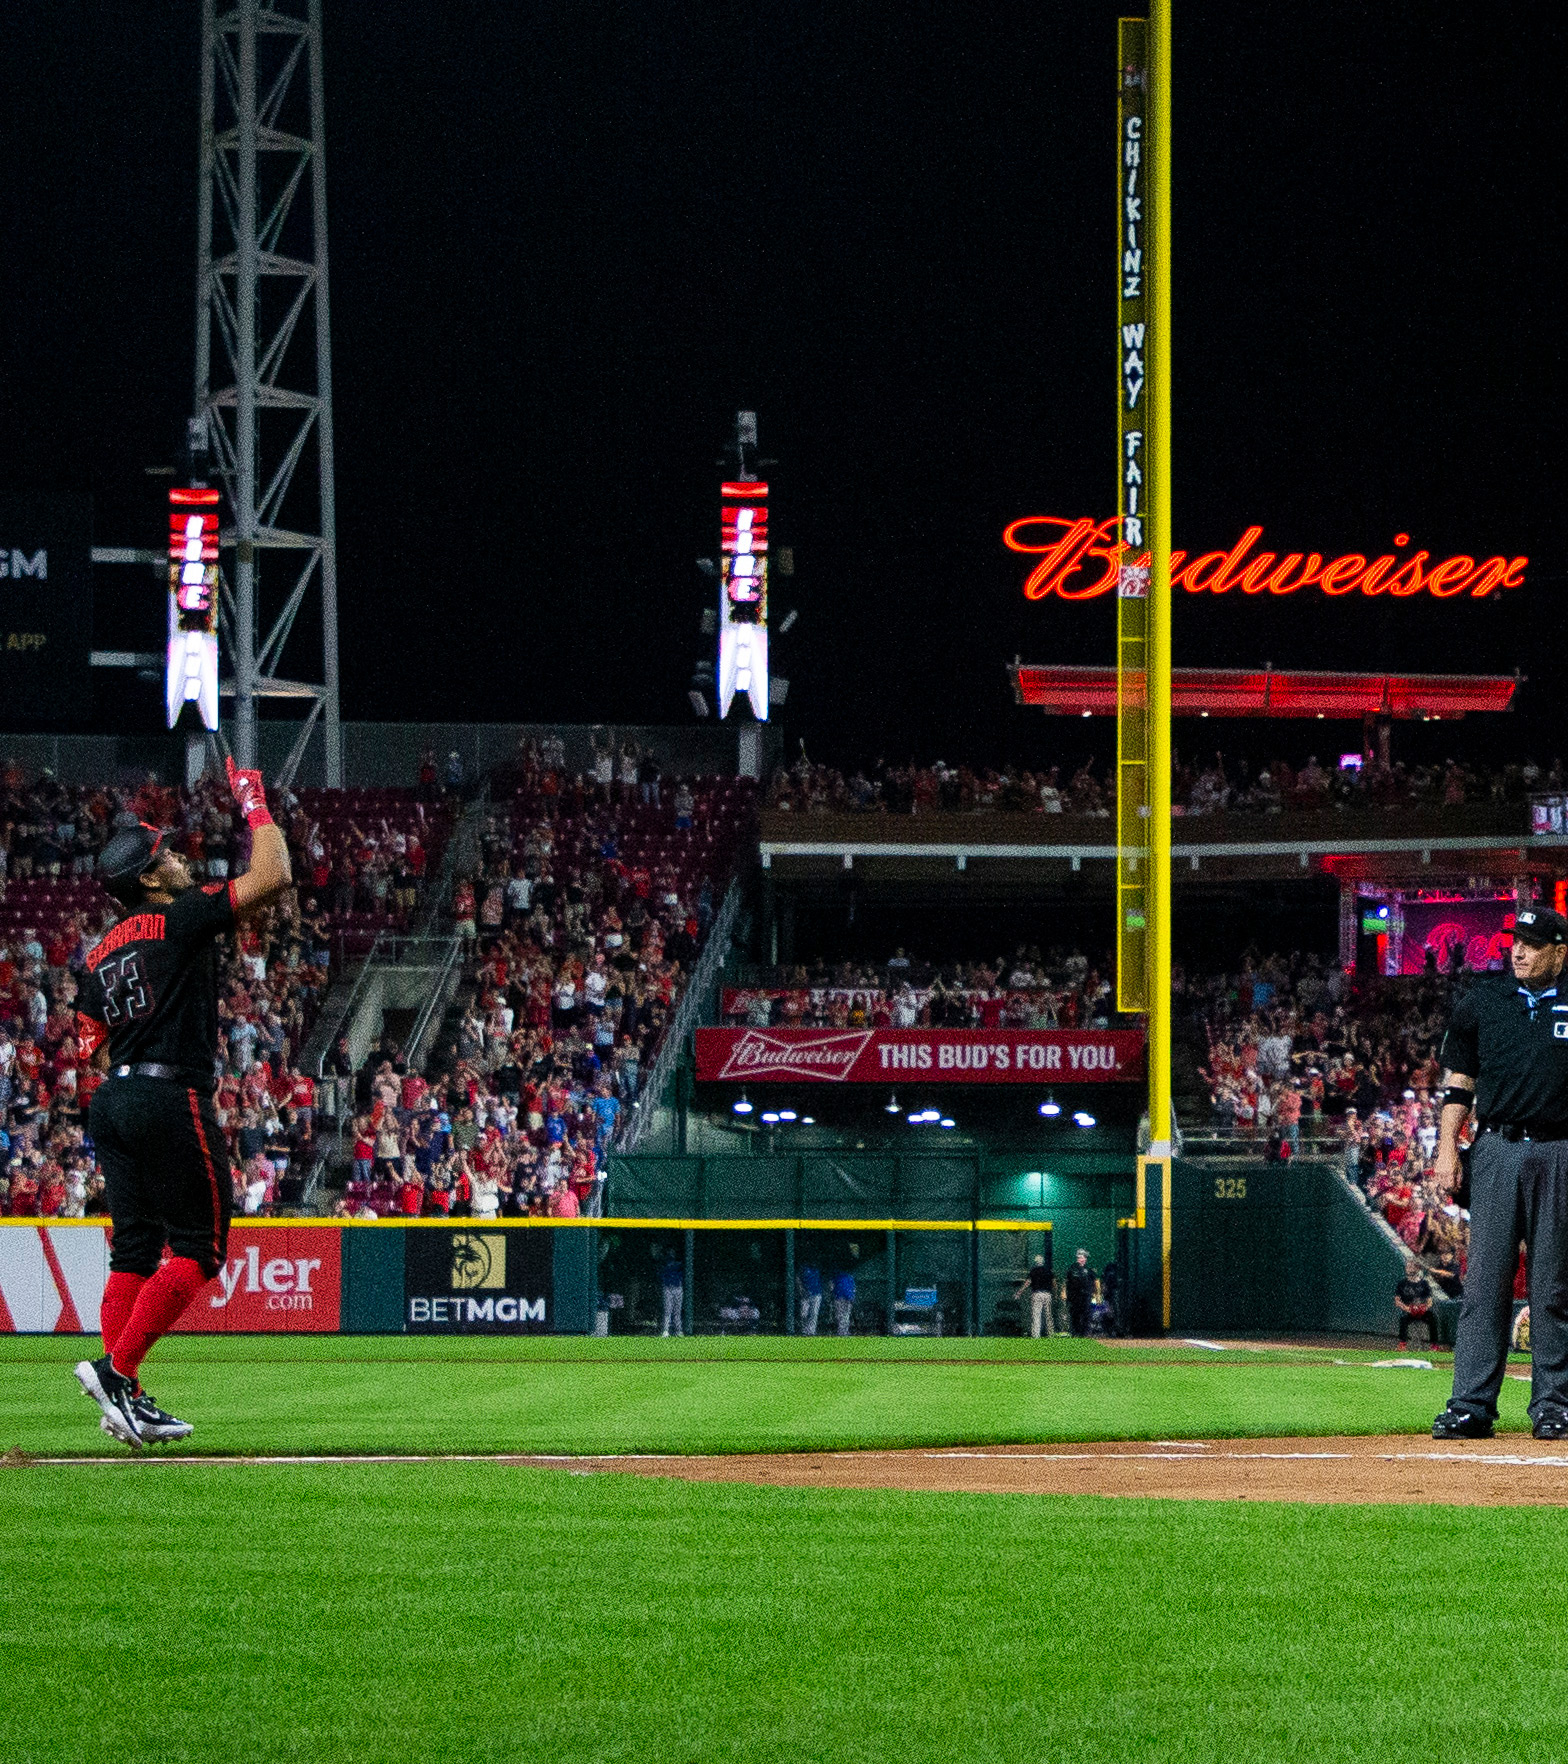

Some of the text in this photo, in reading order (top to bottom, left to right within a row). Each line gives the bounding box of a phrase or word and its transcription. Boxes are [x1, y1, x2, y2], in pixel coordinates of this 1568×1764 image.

[1124, 116, 1142, 297] CHIKINZ
[1122, 323, 1145, 408] WAY
[1125, 431, 1142, 547] FAIR
[736, 1040, 857, 1067] Budweiser
[878, 1044, 1122, 1070] THIS BUD'S FOR YOU.
[1215, 1178, 1247, 1199] 325
[211, 1245, 321, 1308] yler
[410, 1296, 546, 1323] BETMGM
